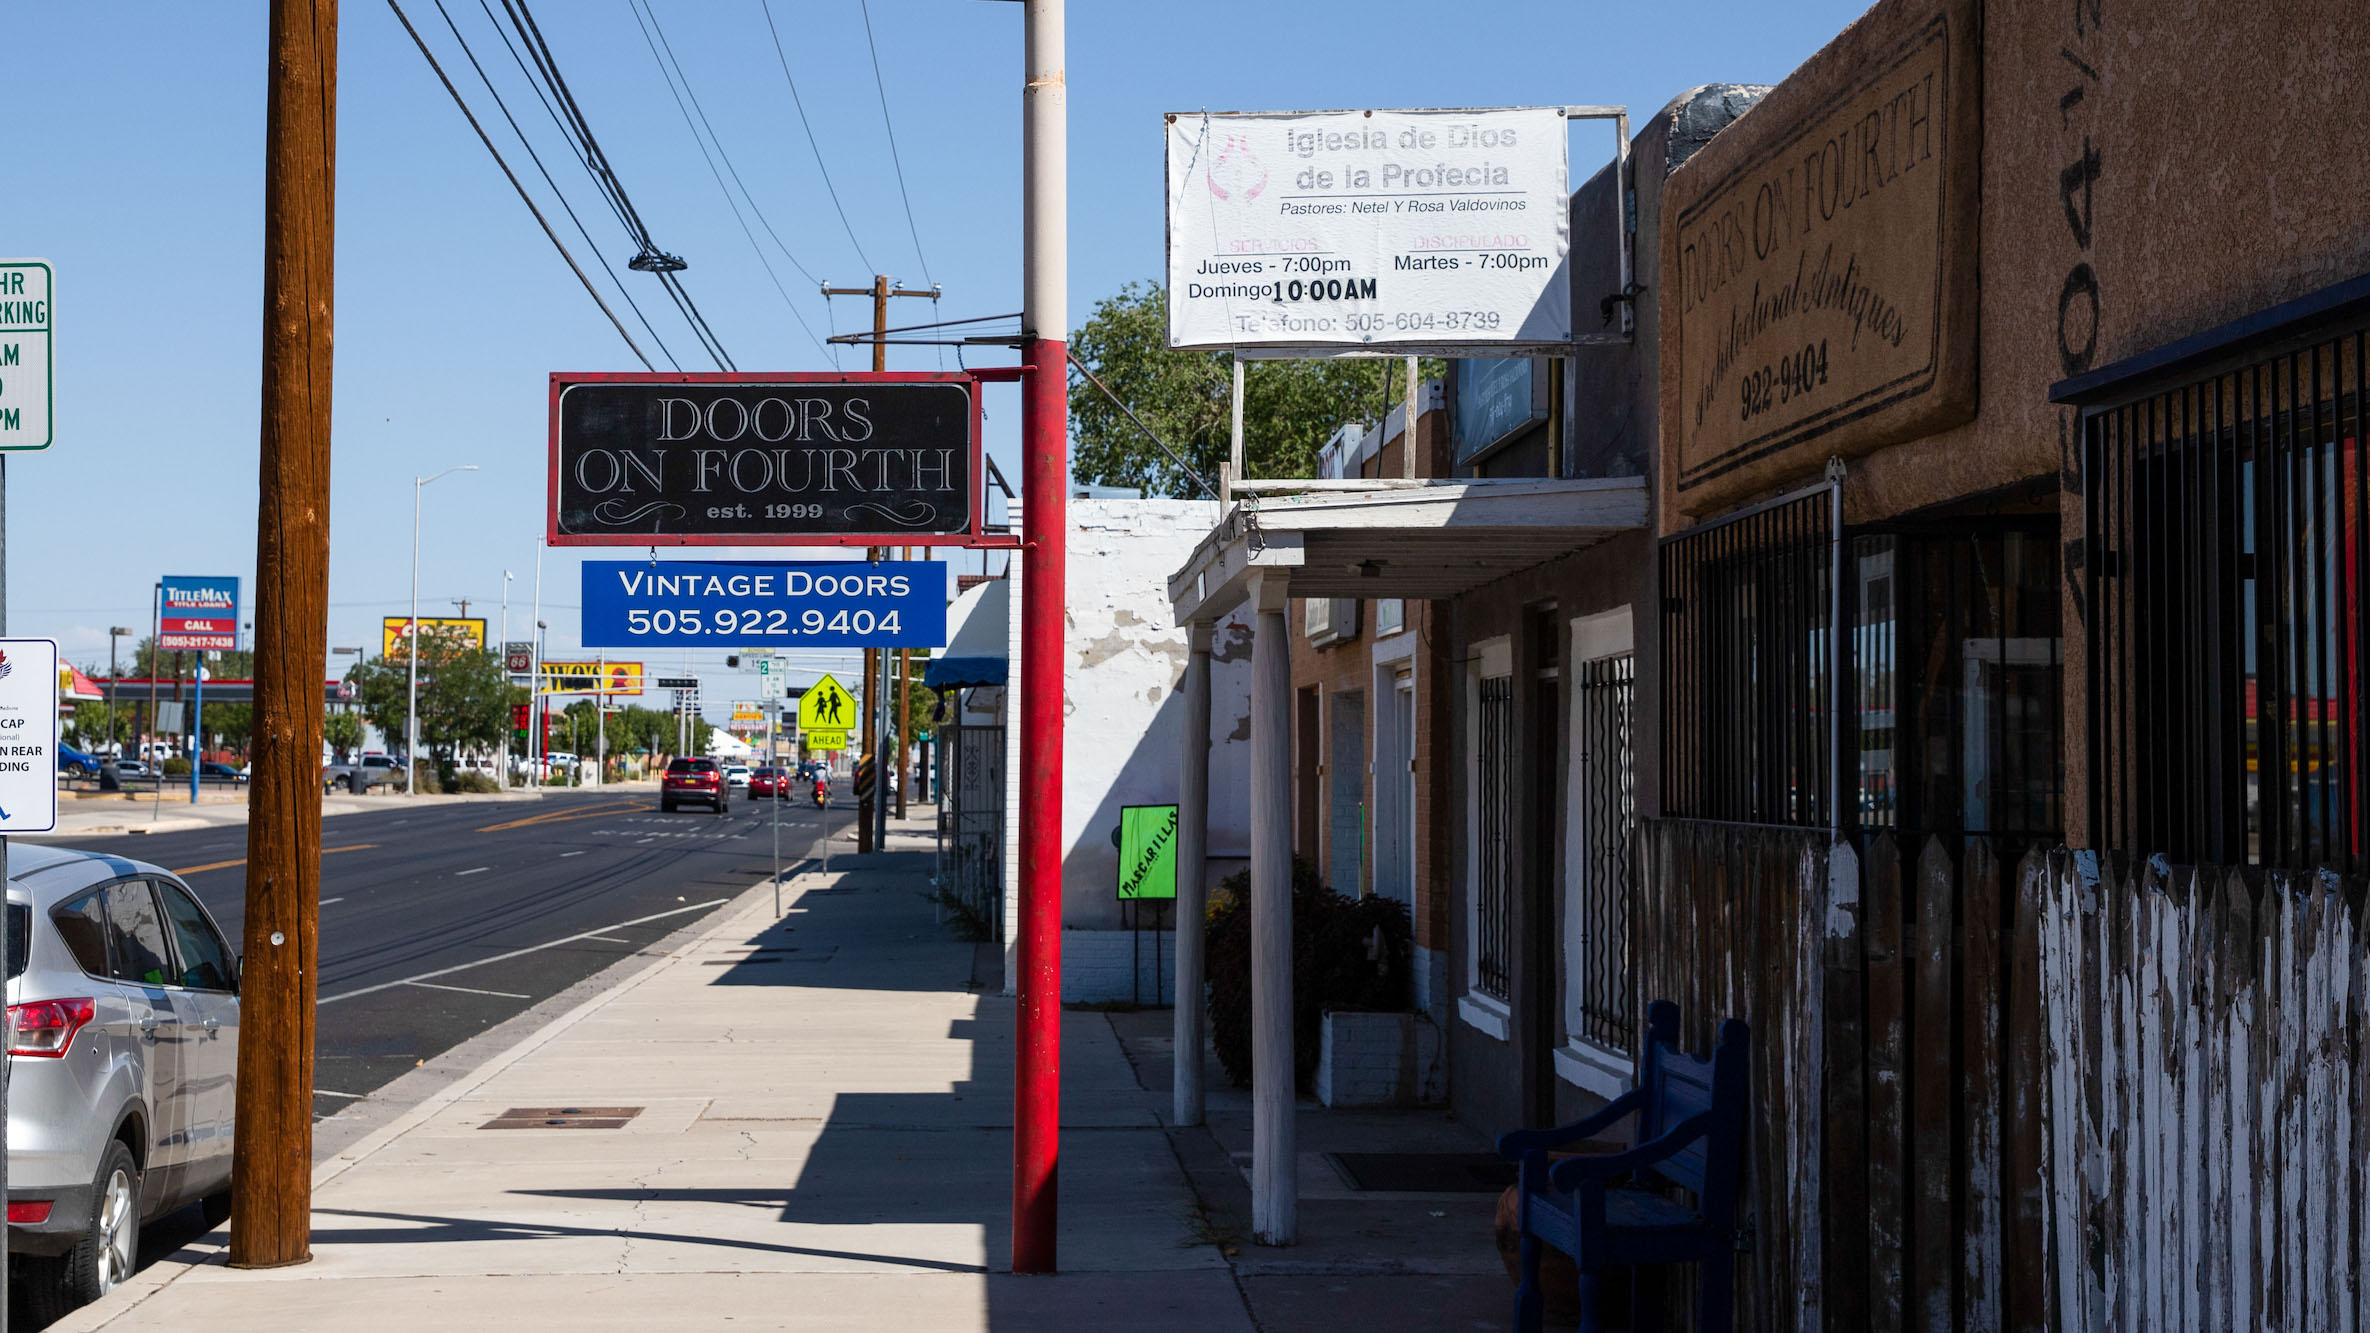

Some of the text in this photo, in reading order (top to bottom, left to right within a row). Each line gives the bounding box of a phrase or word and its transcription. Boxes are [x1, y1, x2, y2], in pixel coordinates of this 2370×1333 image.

[1287, 124, 1518, 159] Iglesia de Dios
[1295, 161, 1509, 190] de la Profecia
[1685, 71, 1934, 314] DOORS ON FOURTH
[1280, 199, 1527, 215] Pastores: Netel Y Rosa Valdovinos
[1229, 238, 1319, 253] SERVICIOS
[1414, 234, 1529, 249] DISCIPULADO
[1196, 259, 1263, 275] Jueves
[1281, 256, 1351, 275] 7:00pm
[1394, 255, 1459, 270] Martes
[1478, 253, 1549, 272] 7:00pm
[1189, 282, 1272, 300] Domingo
[0, 300, 46, 324] KING
[1344, 311, 1500, 332] 505-604-8739
[1691, 241, 1908, 447] Architectural Antiques
[1740, 337, 1829, 421] 922-9404
[656, 397, 874, 442] DOORS
[574, 448, 956, 494] ON FOURTH
[706, 503, 824, 519] est. 1999
[618, 570, 911, 597] VINTAGE DOORS
[184, 620, 214, 632] CALL
[627, 608, 902, 636] 505.922.9404
[510, 656, 528, 668] 66
[761, 661, 768, 674] 2
[812, 735, 842, 745] AHEAD
[11, 746, 43, 756] REAR
[1121, 811, 1177, 897] MASCARILLAS
